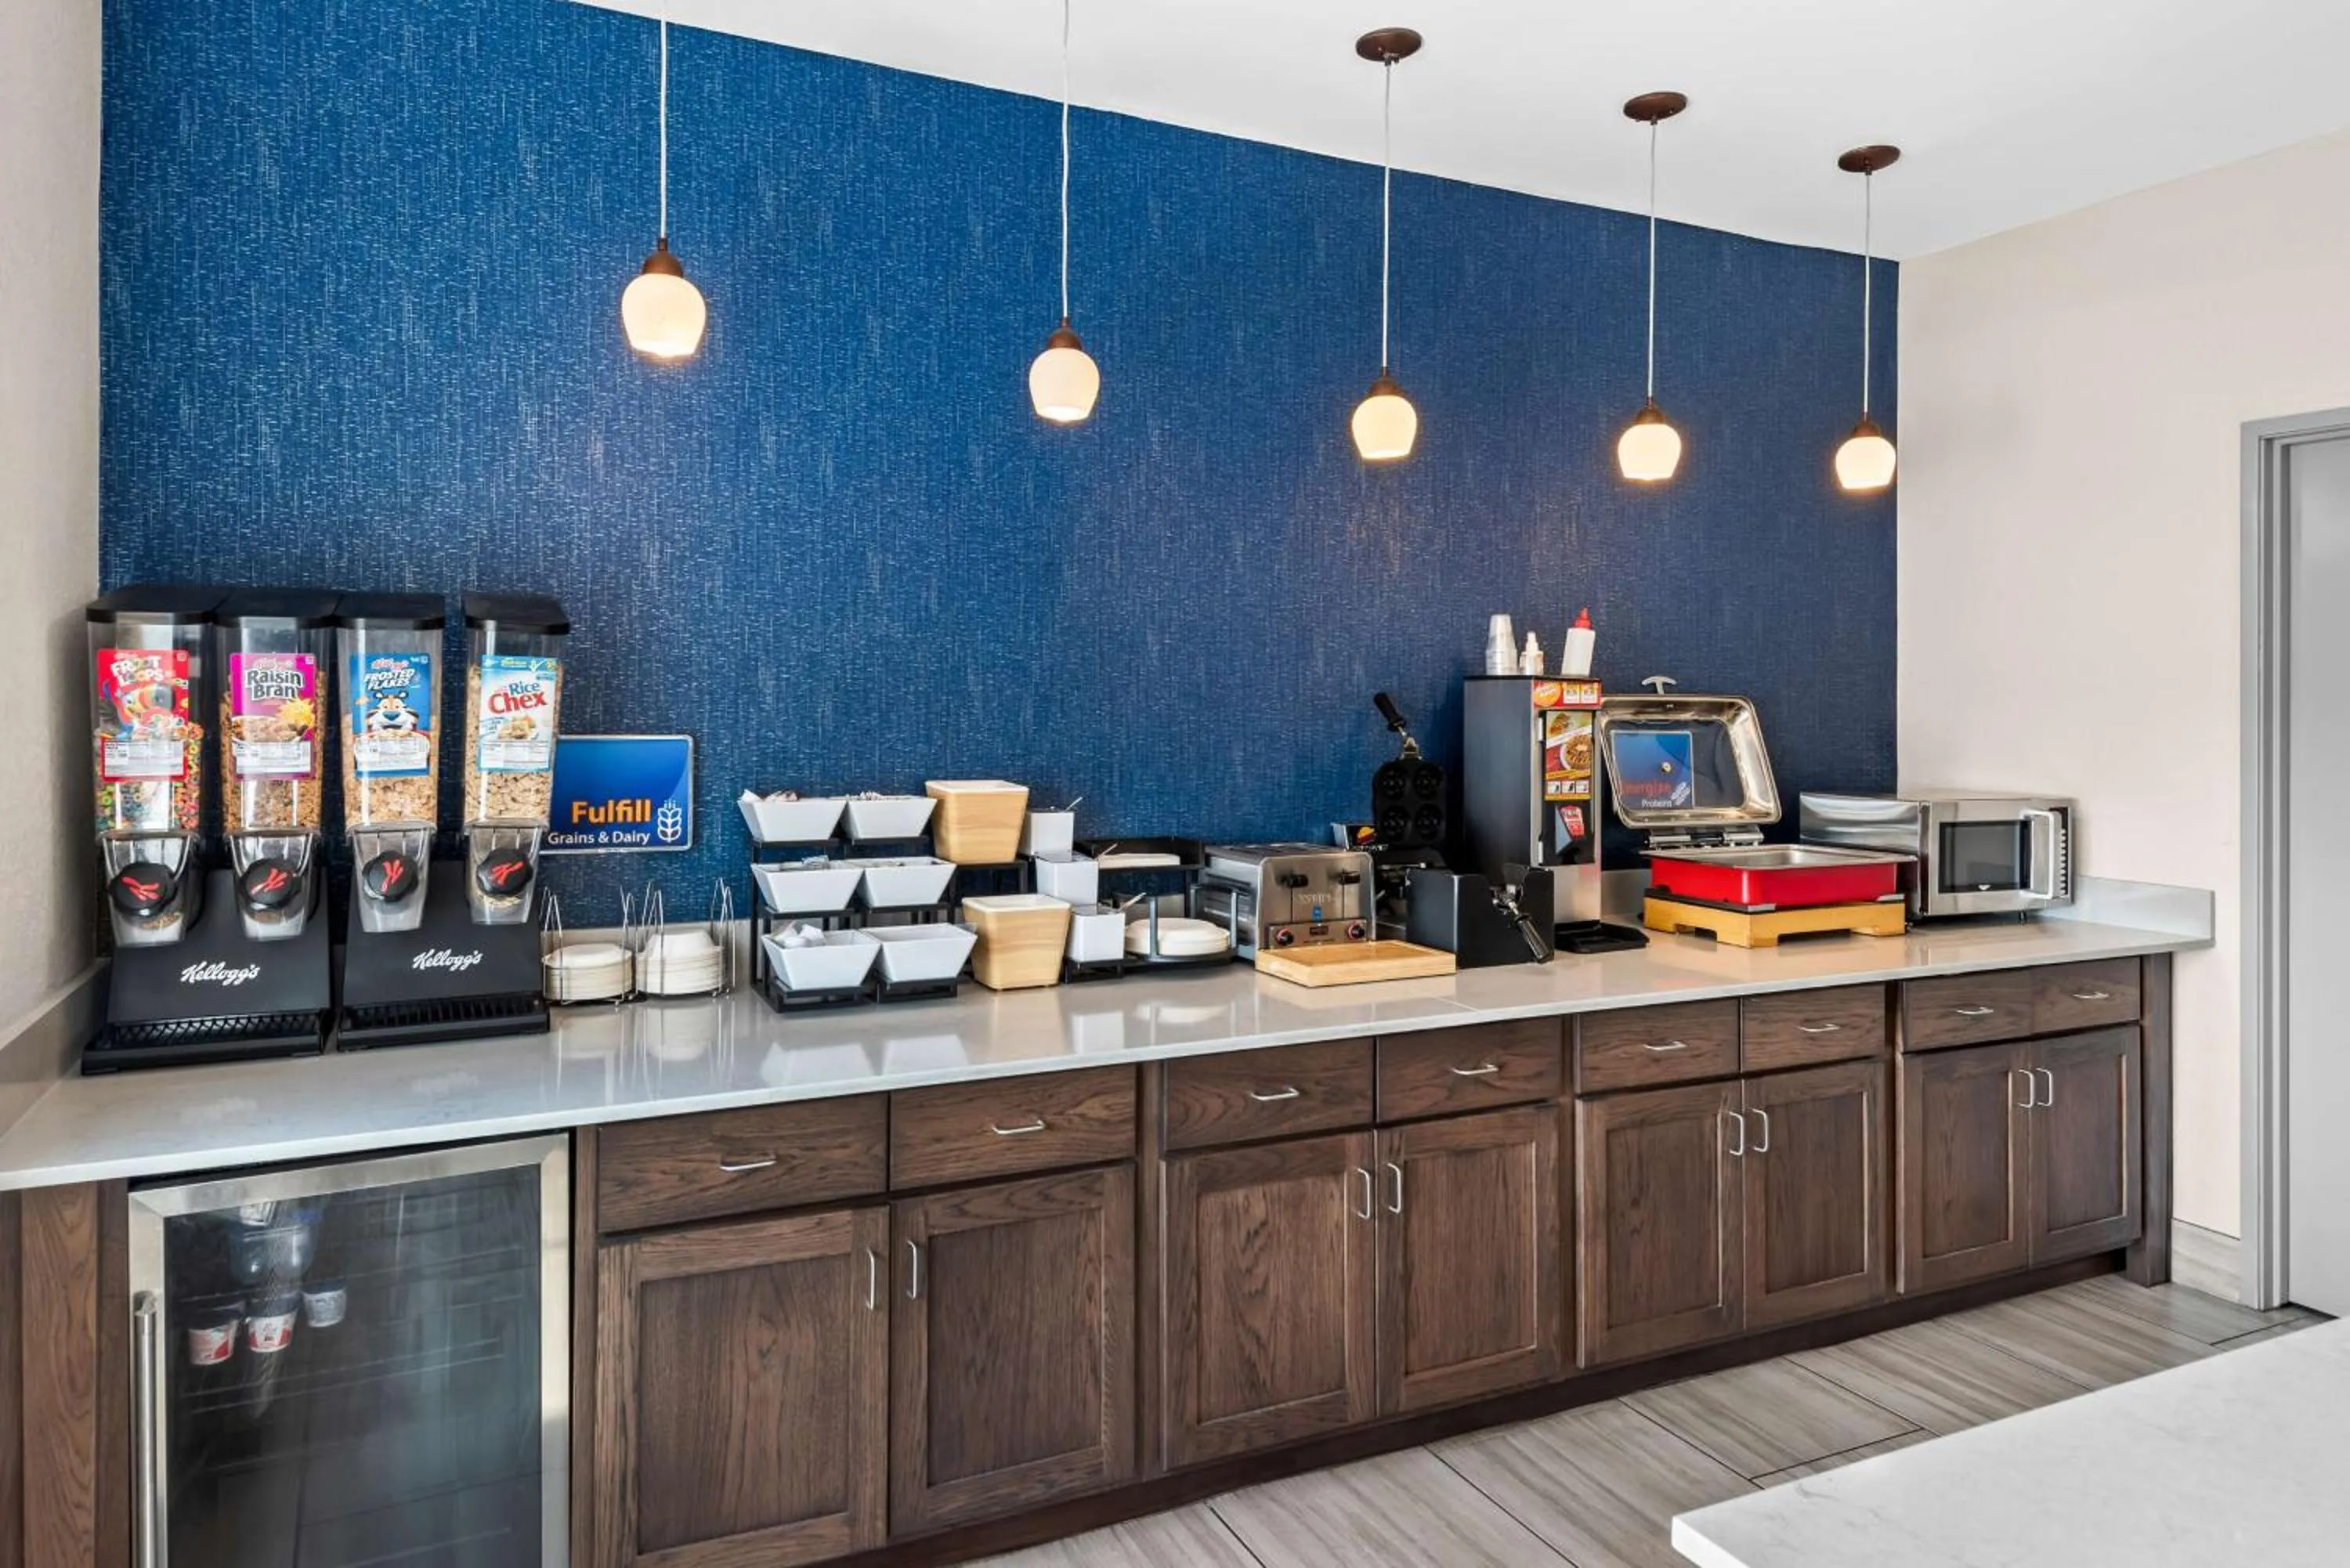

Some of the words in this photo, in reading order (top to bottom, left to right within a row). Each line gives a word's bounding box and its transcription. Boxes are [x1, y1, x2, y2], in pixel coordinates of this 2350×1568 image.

[246, 669, 303, 688] Raisin
[363, 668, 415, 683] FROSTED
[368, 678, 409, 690] FLAKES
[252, 683, 295, 699] Bran
[508, 681, 540, 696] Rice
[489, 692, 547, 714] Chex
[572, 799, 652, 824] Fulfill
[548, 831, 595, 844] Grains
[598, 831, 609, 844] &
[612, 830, 650, 845] Dairy
[412, 948, 483, 971] Kellogg's
[179, 960, 261, 986] Kellogg's
